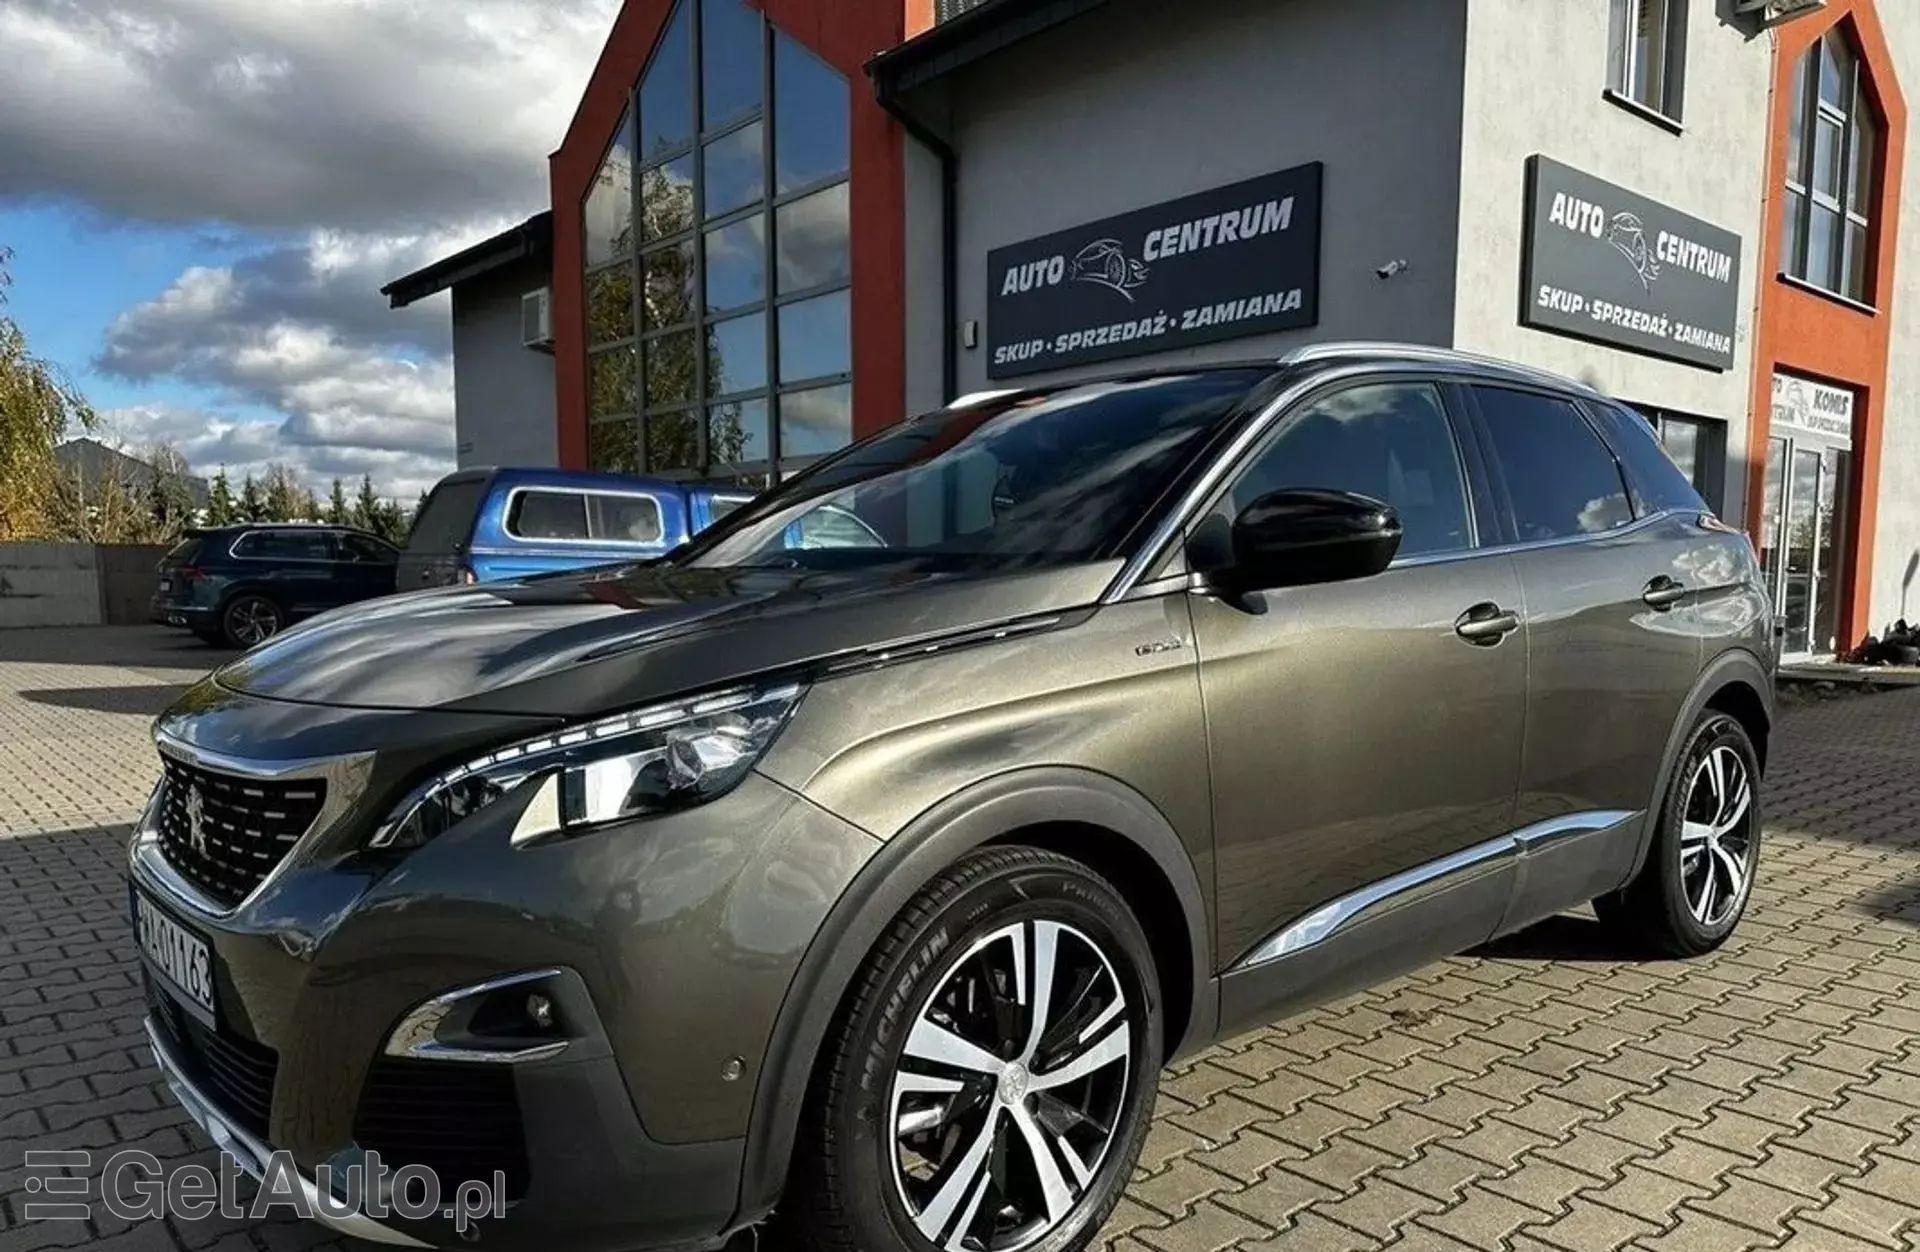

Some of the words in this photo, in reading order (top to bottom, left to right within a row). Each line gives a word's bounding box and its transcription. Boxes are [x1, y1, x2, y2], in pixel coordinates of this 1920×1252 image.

[1001, 255, 1064, 296] AUTO
[1143, 197, 1294, 261] CENTRUM
[1549, 192, 1604, 239] AUTO
[1656, 231, 1732, 283] CENTRUM
[994, 339, 1043, 364] SKUP
[1055, 310, 1167, 353] SPRZEDAŻ
[1182, 288, 1302, 330] ZAMIANA
[1538, 285, 1583, 313] SKUP
[1592, 300, 1667, 337] SPRZEDAŻ
[1675, 322, 1731, 354] ZAMIANA
[1814, 388, 1849, 416] KOMIS
[860, 925, 950, 1091] MICHELIN
